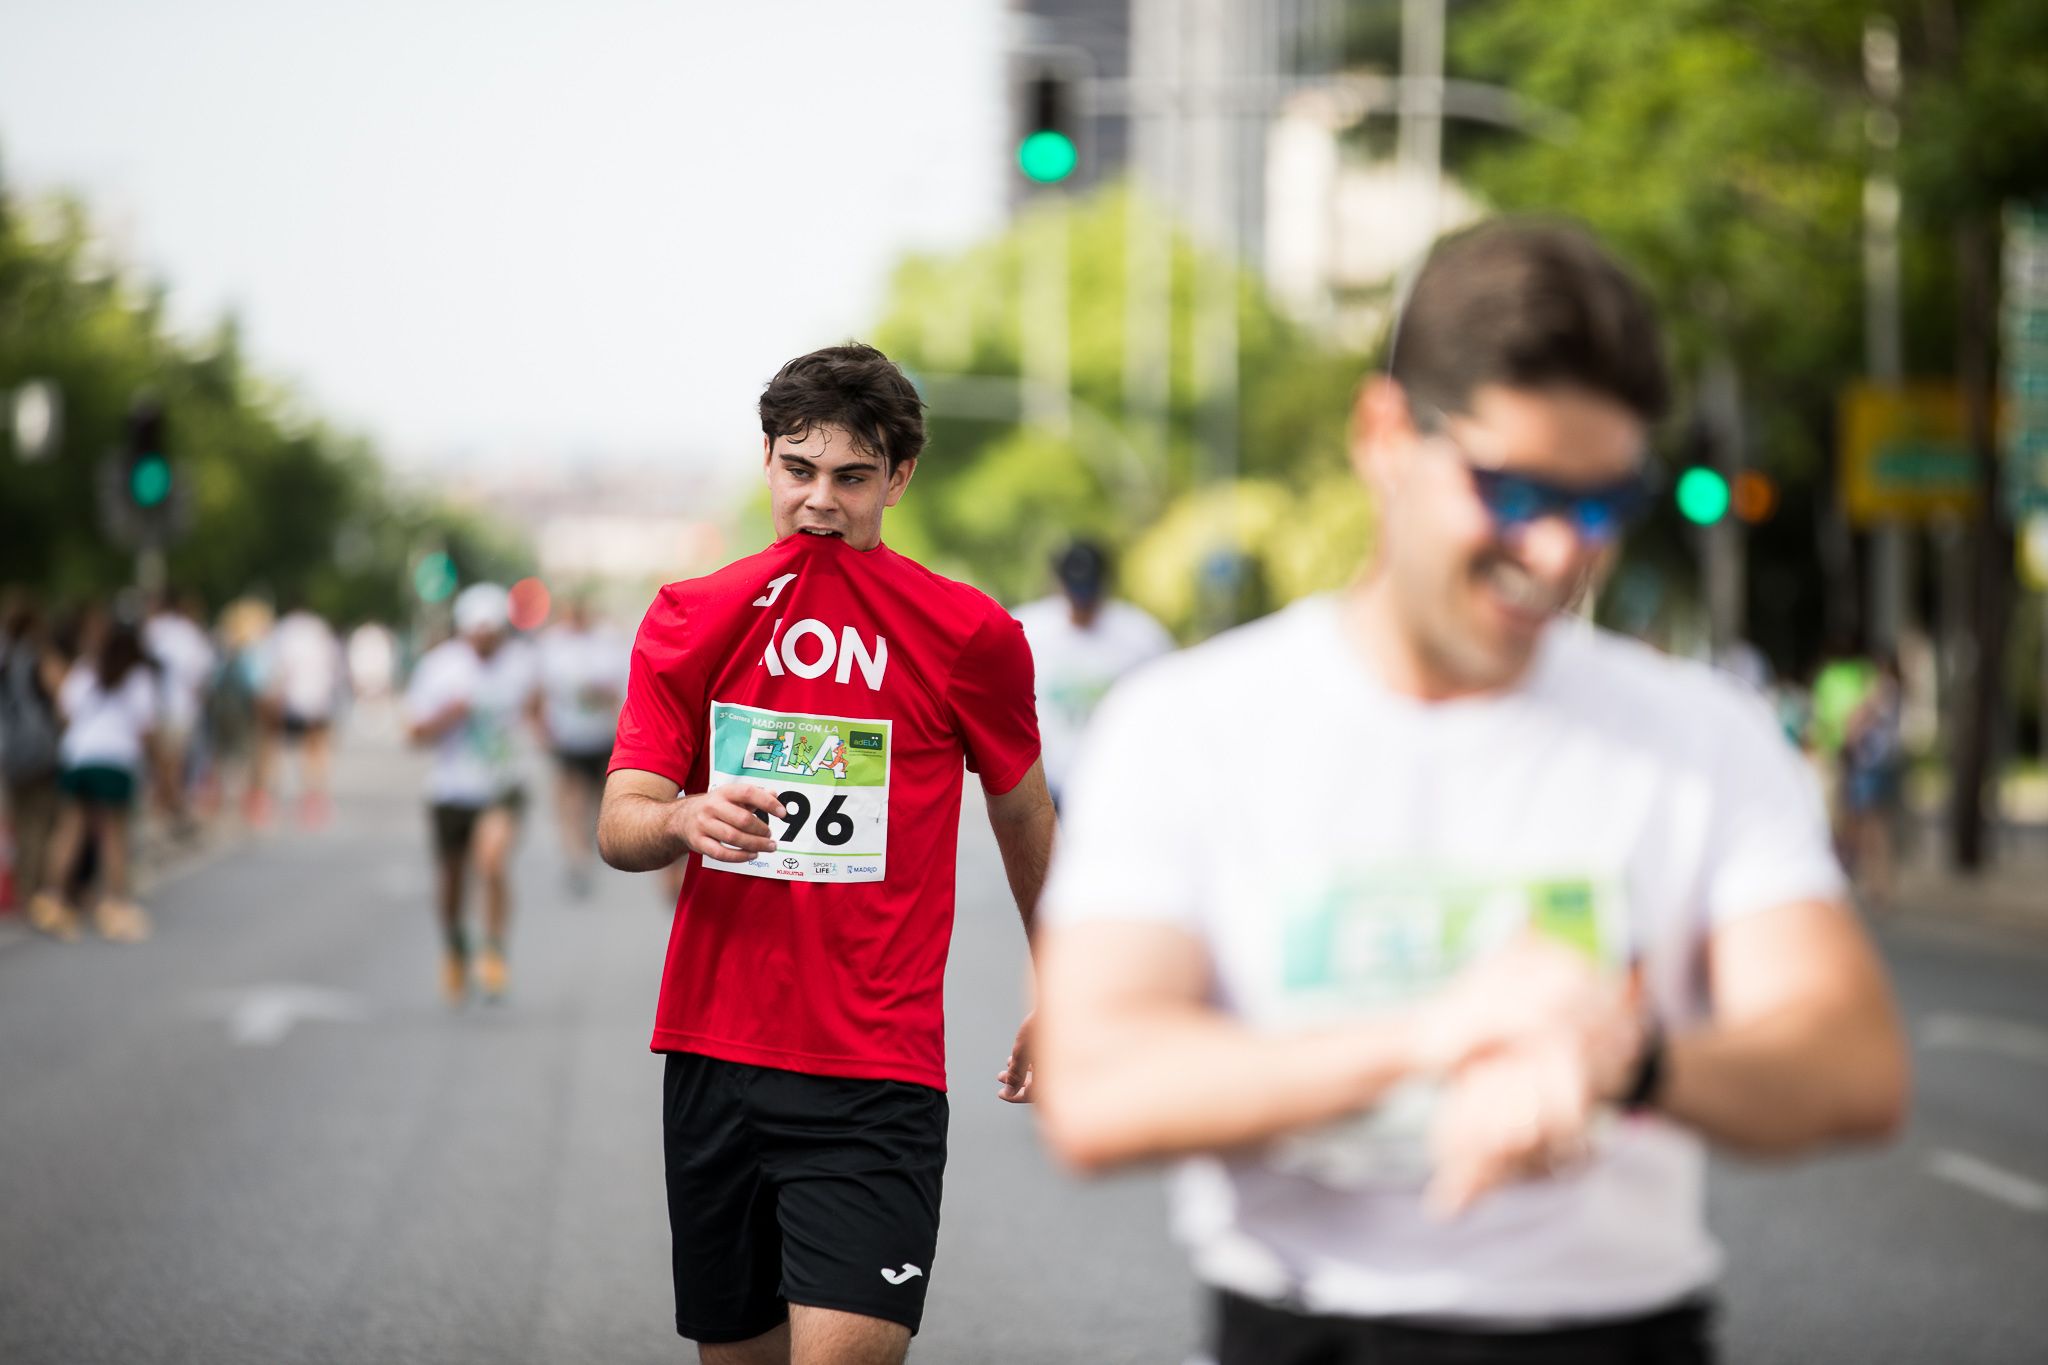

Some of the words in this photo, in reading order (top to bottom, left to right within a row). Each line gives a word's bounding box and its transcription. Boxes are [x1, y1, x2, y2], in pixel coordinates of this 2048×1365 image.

[752, 718, 796, 730] MADRID
[798, 722, 822, 733] CON
[824, 725, 840, 734] LA
[742, 728, 847, 779] ELA
[755, 790, 854, 846] 96
